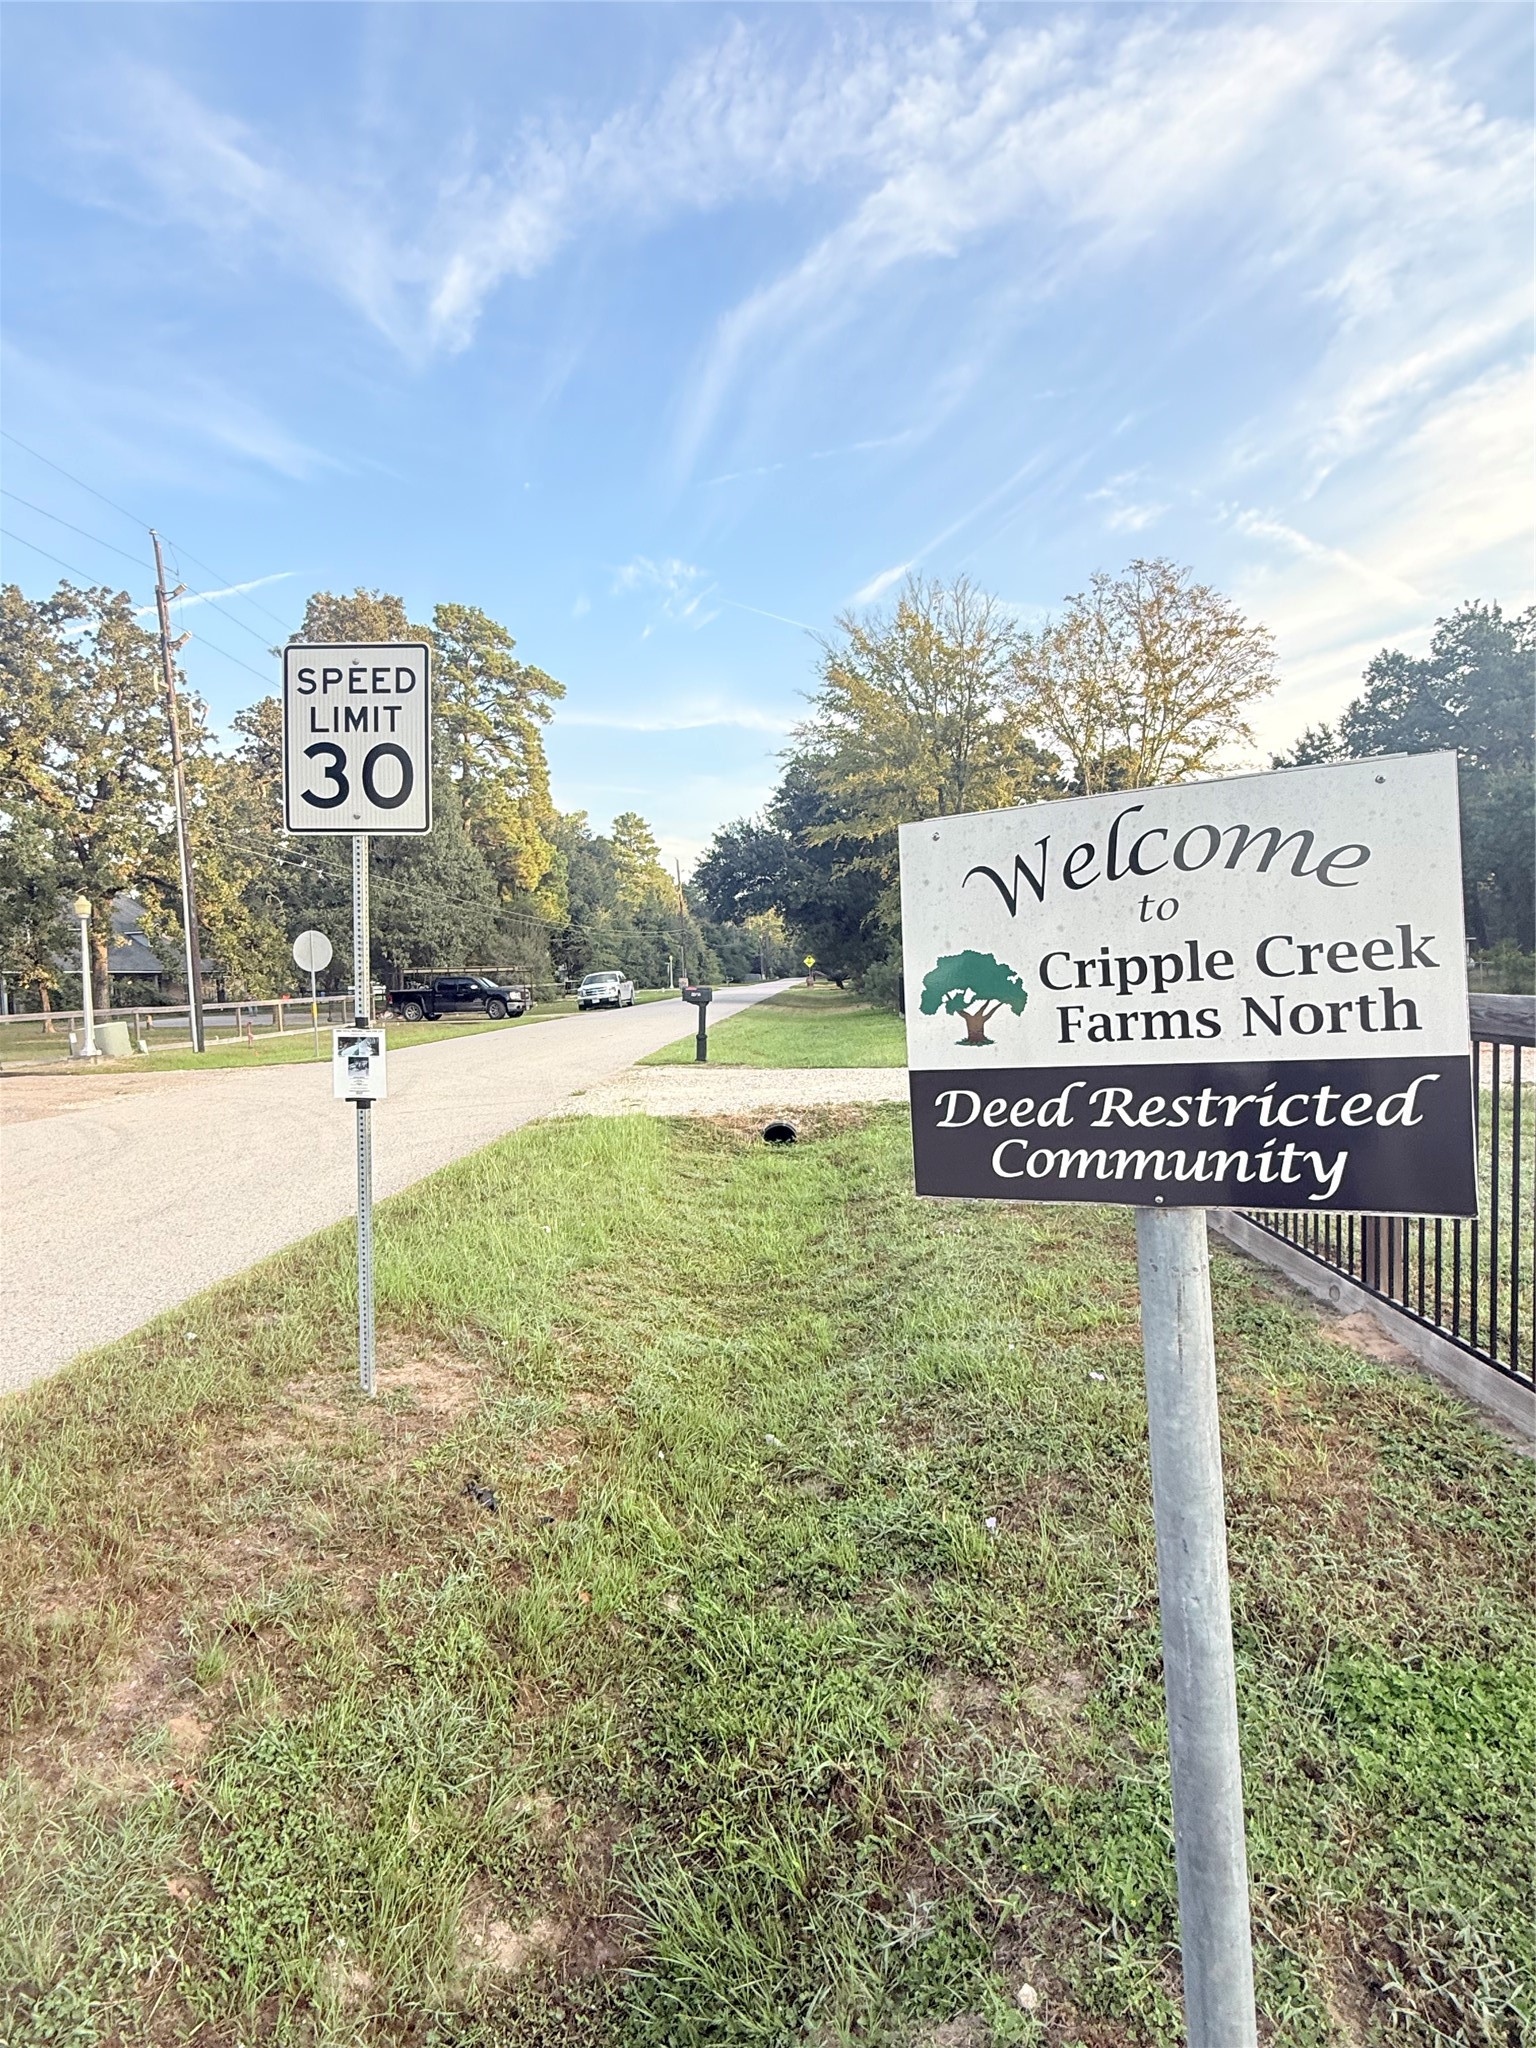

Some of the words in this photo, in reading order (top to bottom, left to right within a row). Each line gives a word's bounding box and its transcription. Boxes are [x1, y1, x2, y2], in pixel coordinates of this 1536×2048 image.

[297, 667, 416, 695] SPEED
[310, 706, 402, 732] LIMIT
[300, 742, 413, 809] 30
[962, 805, 1371, 918] Welcome
[1138, 894, 1179, 923] to
[1039, 940, 1235, 996] Cripple
[1256, 924, 1440, 978] Creek
[1057, 1004, 1221, 1044] Farms
[1242, 986, 1423, 1037] North
[935, 1081, 1086, 1129] Deed
[1089, 1074, 1440, 1129] Restricted
[992, 1137, 1348, 1201] Community
